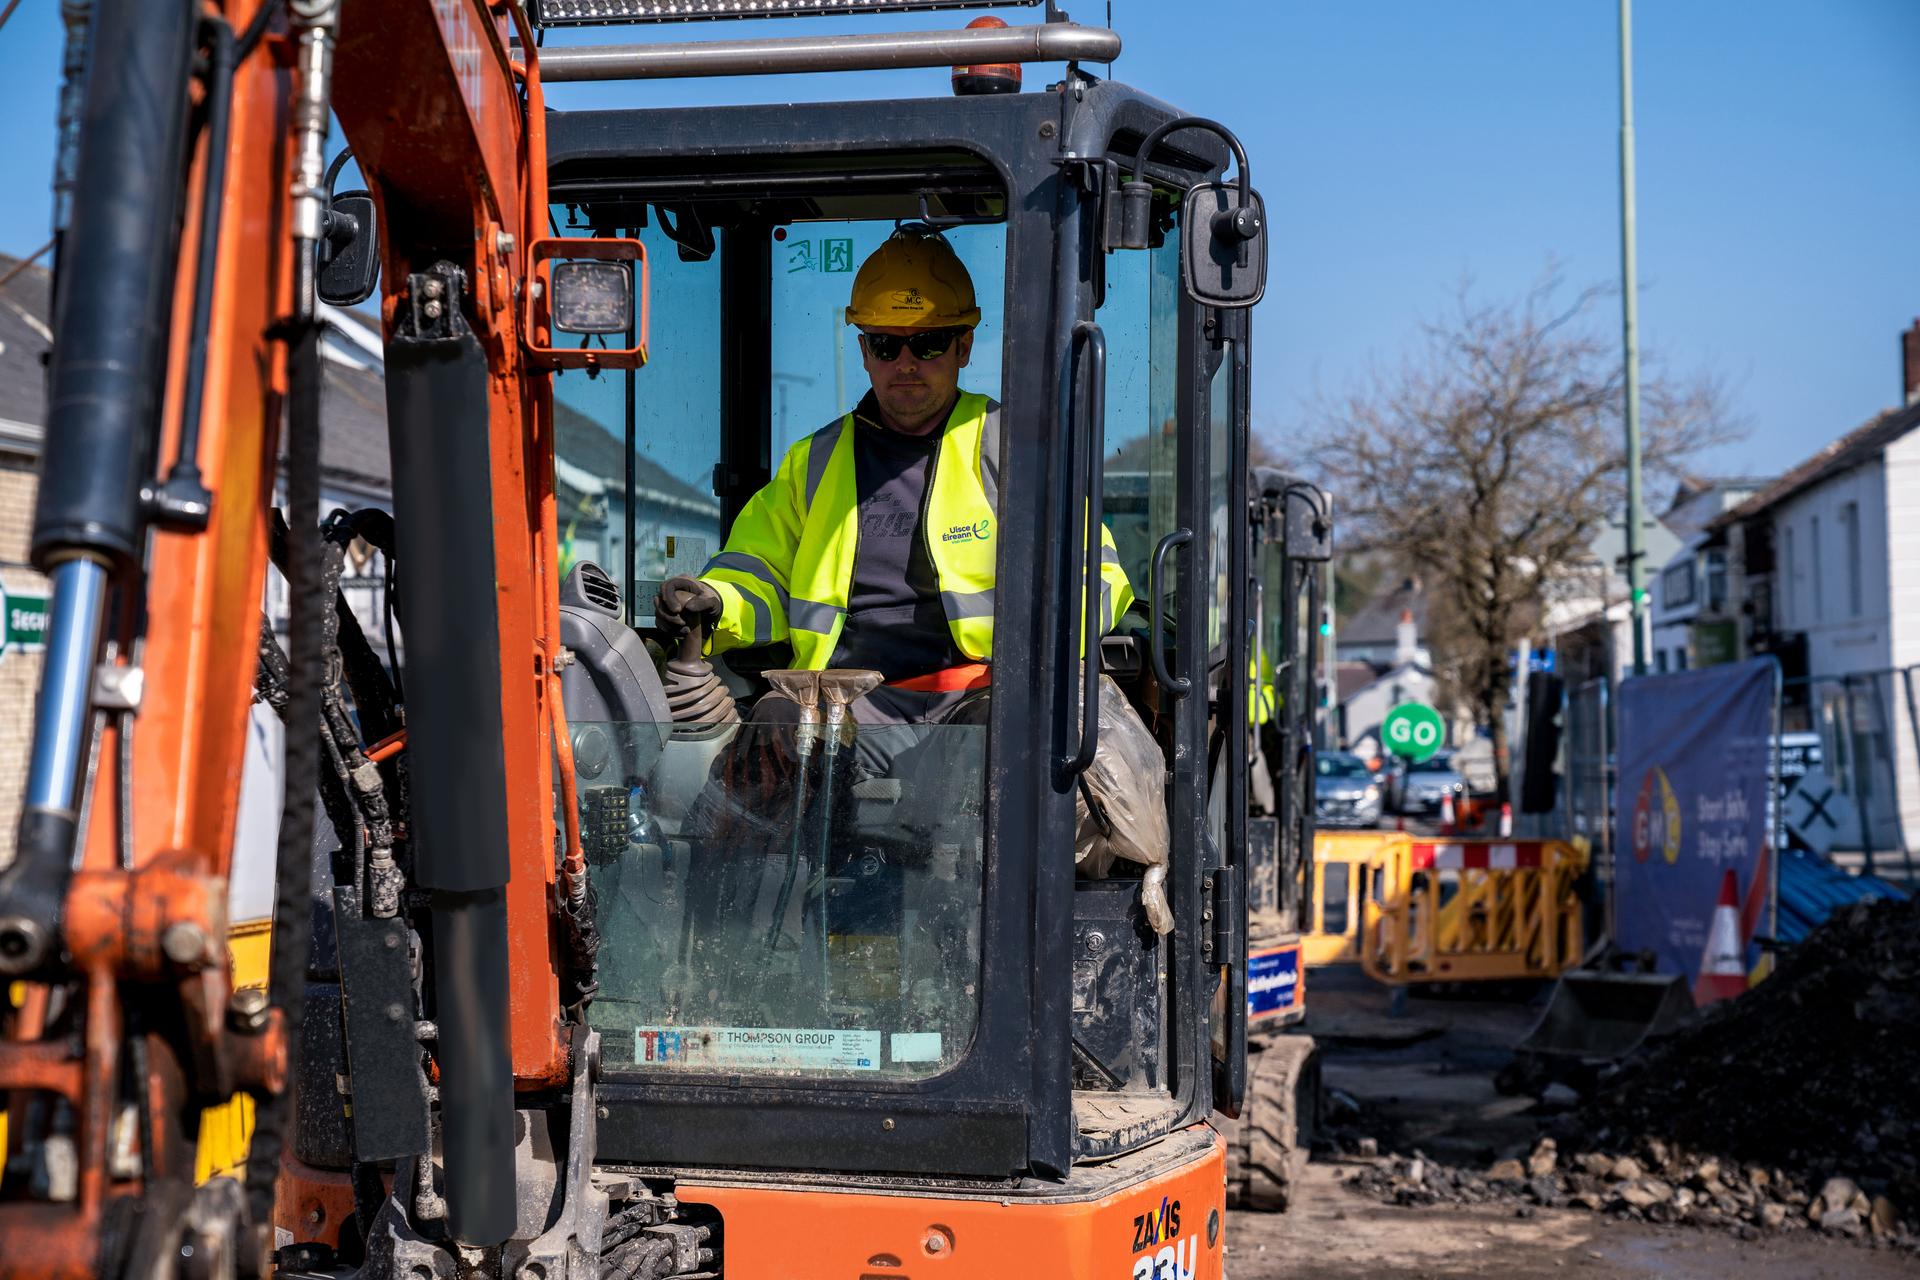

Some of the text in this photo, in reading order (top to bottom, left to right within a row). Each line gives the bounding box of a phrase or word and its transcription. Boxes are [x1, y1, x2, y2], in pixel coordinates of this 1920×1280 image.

[943, 531, 972, 542] Éireann
[1390, 717, 1437, 746] GO
[727, 1031, 792, 1044] THOMPSON
[795, 1033, 835, 1045] GROUP
[1132, 1196, 1181, 1254] ZAXIS
